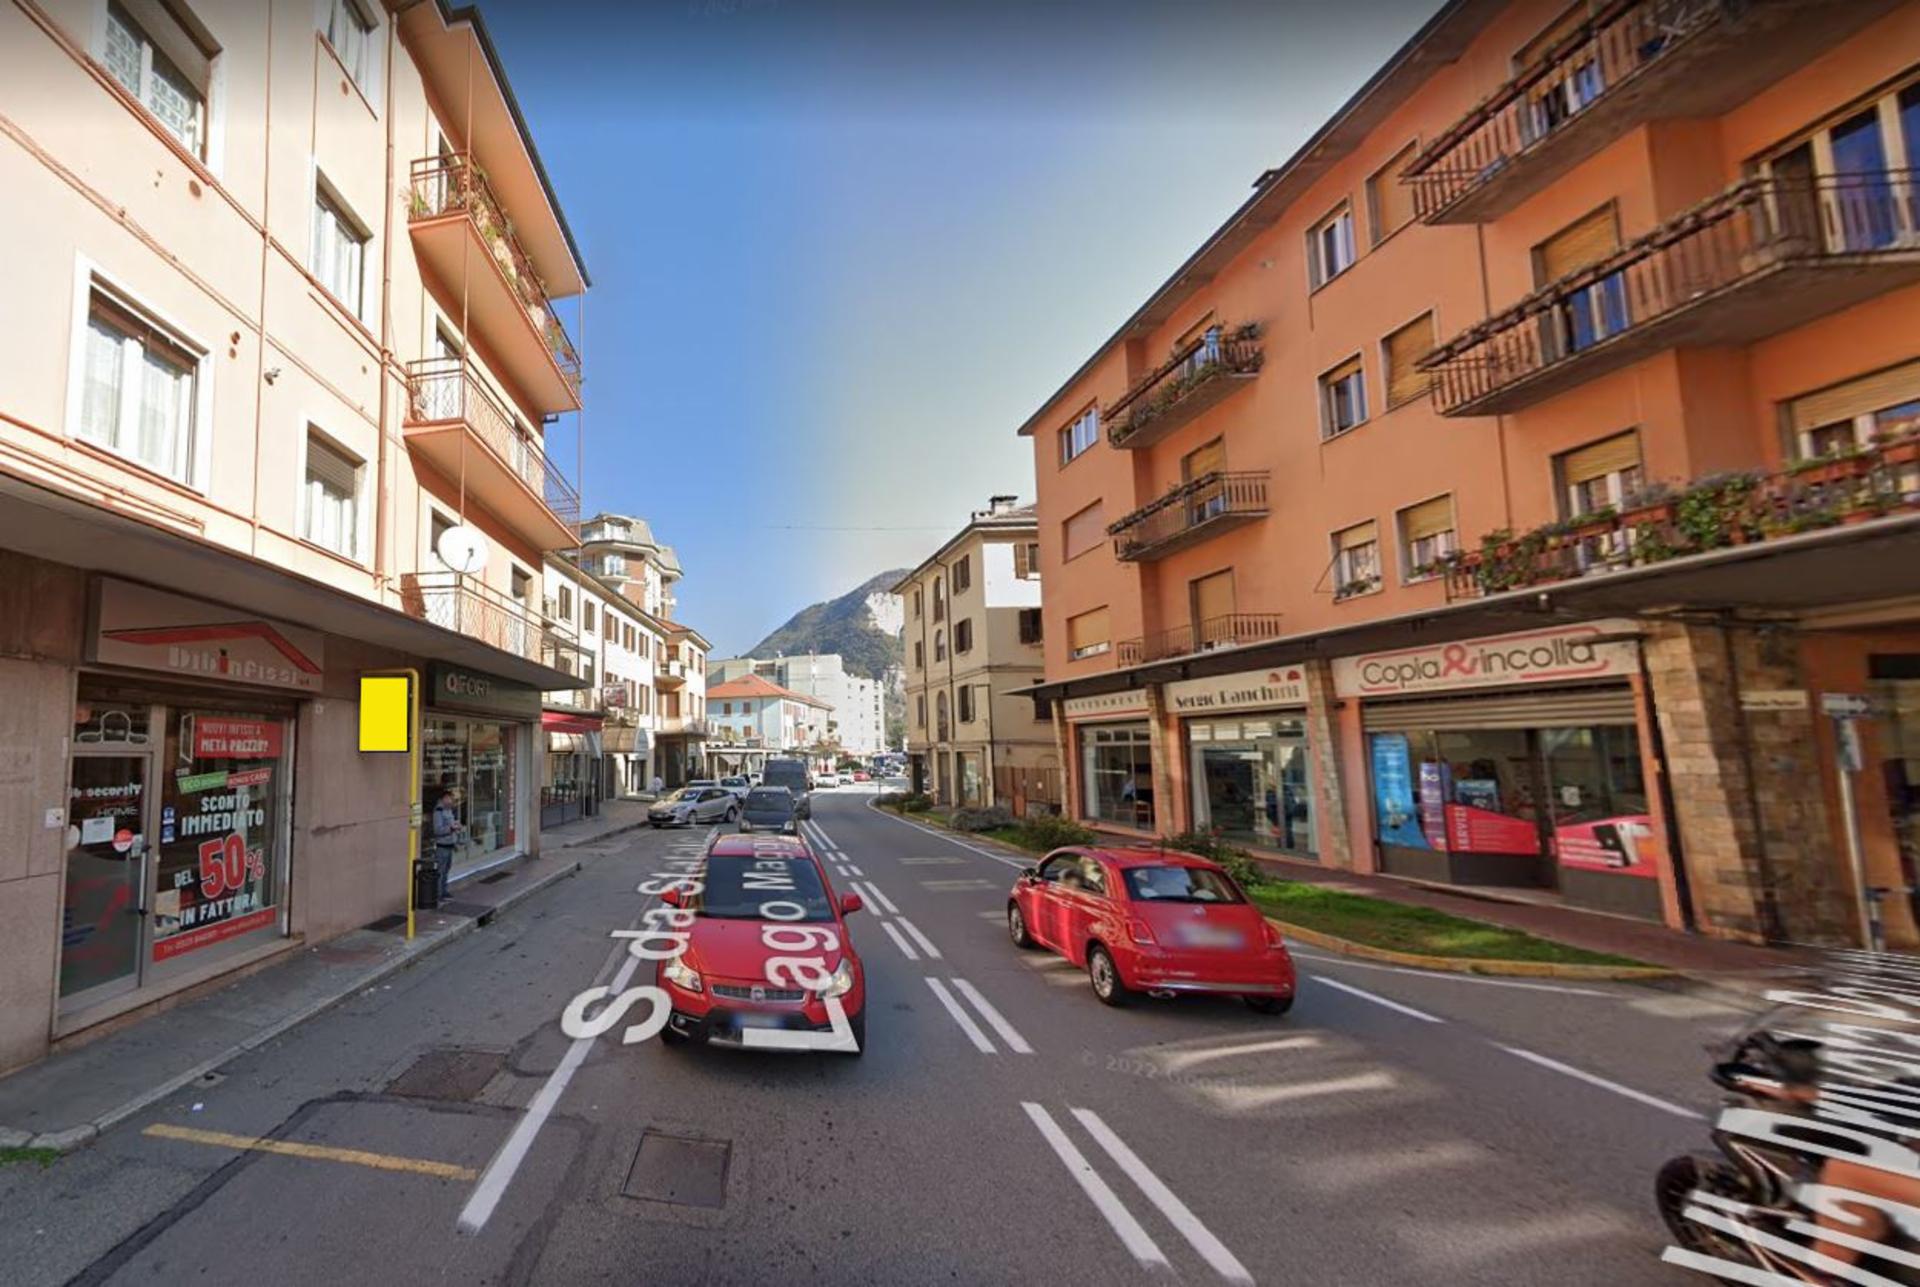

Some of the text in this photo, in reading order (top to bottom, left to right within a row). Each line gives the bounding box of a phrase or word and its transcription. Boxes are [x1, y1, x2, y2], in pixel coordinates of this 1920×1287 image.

[201, 794, 251, 812] SCONTO
[181, 809, 265, 836] IMMEDIATO
[174, 869, 194, 888] DEL
[180, 892, 259, 926] IN FATTURA
